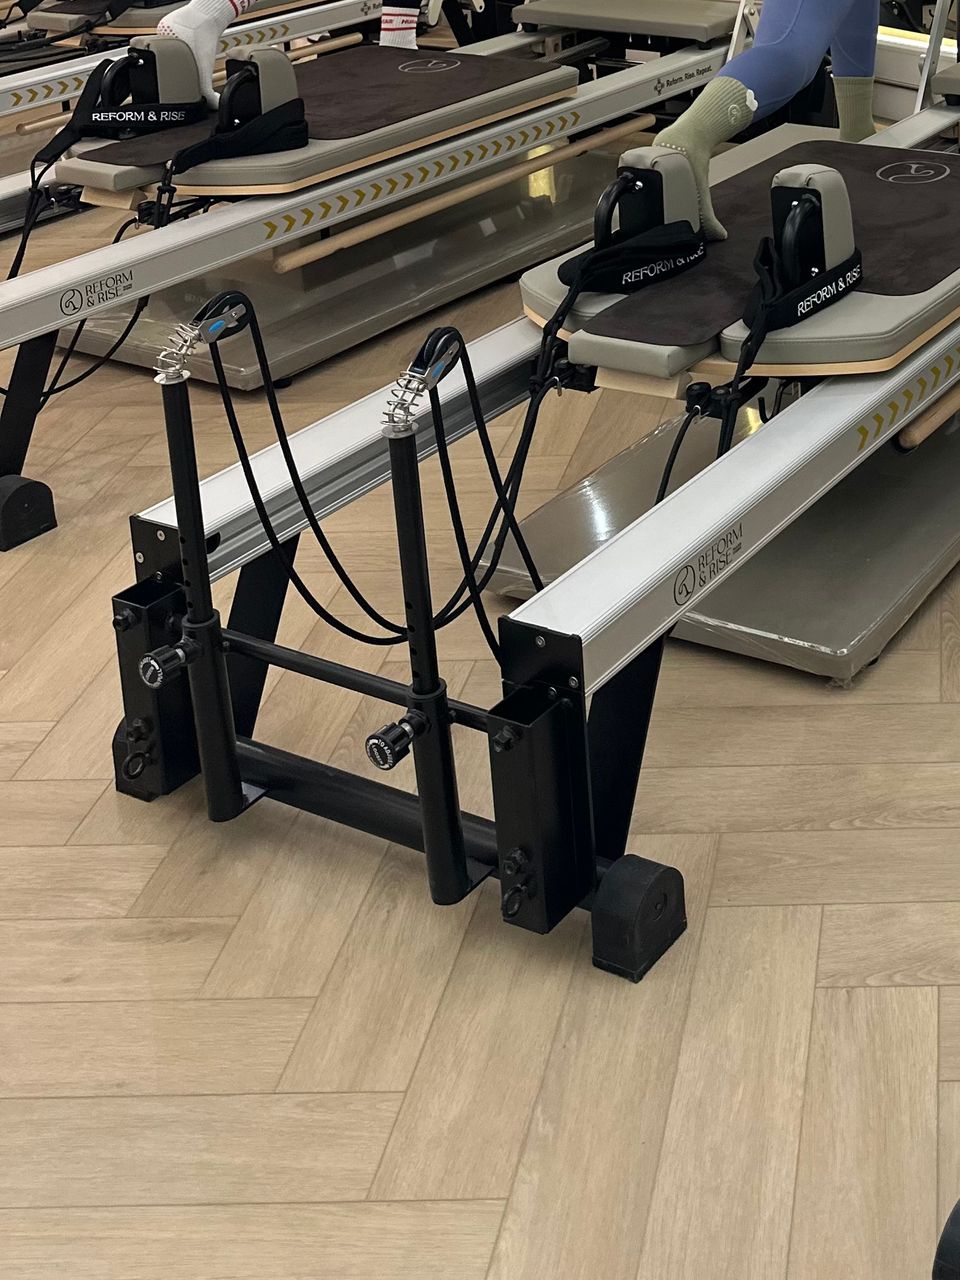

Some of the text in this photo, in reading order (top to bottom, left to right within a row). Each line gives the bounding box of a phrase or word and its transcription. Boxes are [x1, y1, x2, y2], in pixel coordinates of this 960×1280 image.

[92, 110, 186, 122] REFORM & RISE
[85, 269, 133, 296] REFORM
[622, 258, 675, 285] REFORM
[86, 295, 95, 307] &
[97, 284, 122, 304] RISE
[797, 264, 861, 316] REFORM & RISE
[698, 523, 743, 572] REFORM
[699, 570, 707, 588] &
[709, 547, 732, 580] RISE
